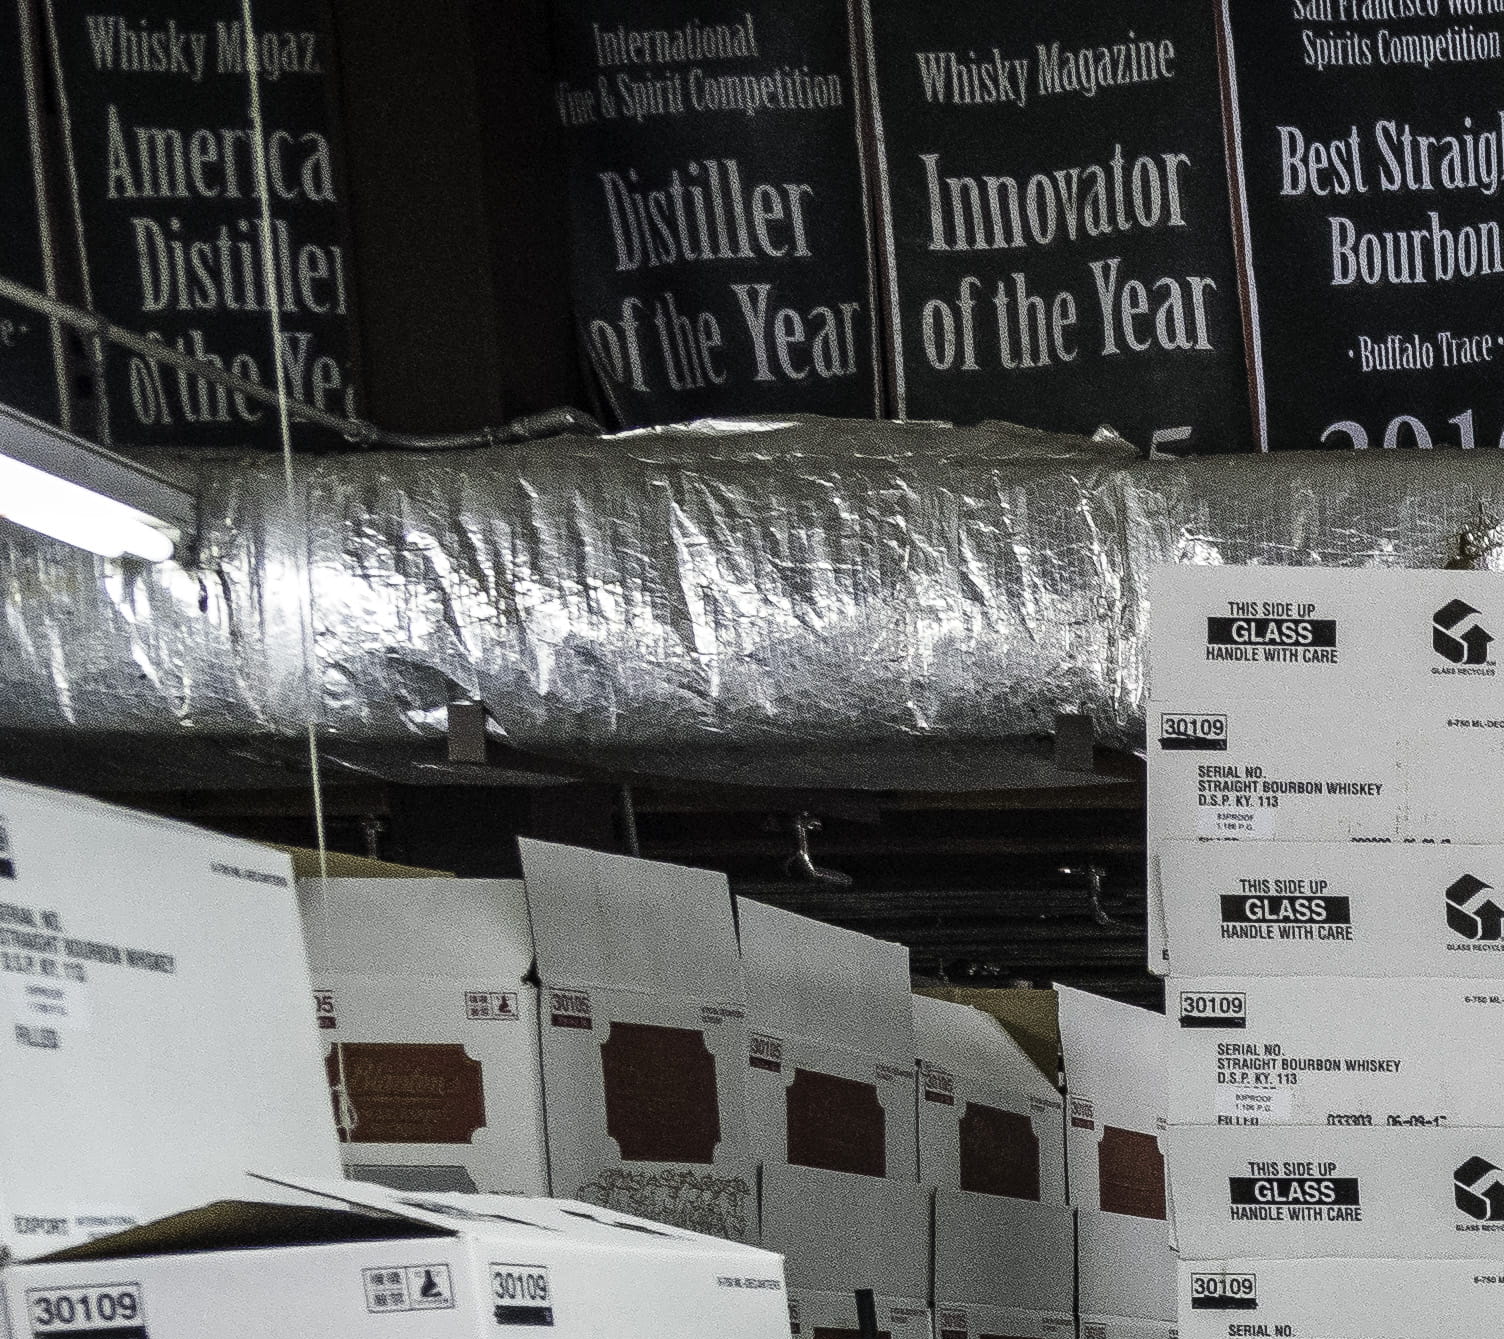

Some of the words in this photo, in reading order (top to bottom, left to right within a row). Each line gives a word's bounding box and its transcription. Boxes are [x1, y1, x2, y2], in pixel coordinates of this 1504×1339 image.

[86, 14, 206, 82] Whisky
[591, 13, 759, 65] International
[1302, 30, 1371, 69] Spirits
[1377, 26, 1502, 66] Competition
[916, 47, 1031, 109] Whisky
[1038, 32, 1175, 97] Magazine
[624, 69, 684, 122] Spirit
[689, 63, 842, 116] Competition
[1278, 122, 1368, 197] Best
[921, 144, 1190, 252] Innovator
[599, 159, 814, 271] Distiller
[1327, 211, 1504, 287] Bourbon
[132, 214, 348, 314] Distille
[921, 276, 981, 371] of
[993, 271, 1078, 368] the
[1090, 255, 1216, 357] Year
[589, 297, 648, 392] of
[655, 291, 726, 390] the
[731, 281, 861, 382] Year
[1360, 334, 1434, 373] Buffalo
[1439, 332, 1494, 367] Trace
[1228, 601, 1259, 617] THIS
[1262, 601, 1292, 617] SIDE
[1297, 601, 1316, 617] UP
[1232, 621, 1313, 644] GLASS
[1206, 646, 1259, 662] HANDLE
[1262, 646, 1298, 663] WITH
[1300, 648, 1338, 664] CARE
[1164, 716, 1225, 738] 30109
[1198, 765, 1240, 779] SERIAL
[1244, 765, 1268, 779] NO.
[1198, 781, 1260, 796] STRAIGHT
[1262, 781, 1322, 795] BOURBON
[1326, 782, 1382, 796] WHISKEY
[1198, 794, 1230, 809] D.S.P.
[1235, 794, 1254, 808] KY.
[1256, 794, 1279, 808] 113
[1240, 879, 1272, 895] THIS
[1274, 879, 1304, 895] SIDE
[1308, 879, 1328, 895] UP
[1244, 899, 1327, 922] GLASS
[1221, 924, 1273, 941] HANDLE
[1277, 924, 1312, 941] WITH
[1314, 926, 1353, 941] CARE
[1182, 994, 1243, 1017] 30109
[1218, 1043, 1259, 1058] SERIAL
[1263, 1043, 1287, 1058] NO.
[1218, 1058, 1279, 1073] STRAIGHT
[1281, 1058, 1342, 1072] BOURBON
[1344, 1059, 1401, 1074] WHISKEY
[1218, 1072, 1249, 1086] D.S.P.
[1254, 1072, 1273, 1086] KY.
[1276, 1071, 1298, 1086] 113
[1248, 1161, 1281, 1177] THIS
[1283, 1162, 1312, 1177] SIDE
[1316, 1162, 1337, 1177] UP
[1254, 1180, 1336, 1204] GLASS
[1230, 1205, 1282, 1221] HANDLE
[1287, 1206, 1321, 1222] WITH
[1324, 1206, 1362, 1222] CARE
[493, 1271, 548, 1304] 30109
[1192, 1276, 1254, 1297] 30109
[33, 1293, 138, 1327] 30109
[1229, 1324, 1269, 1338] SERIAL
[1274, 1324, 1296, 1338] NO.
